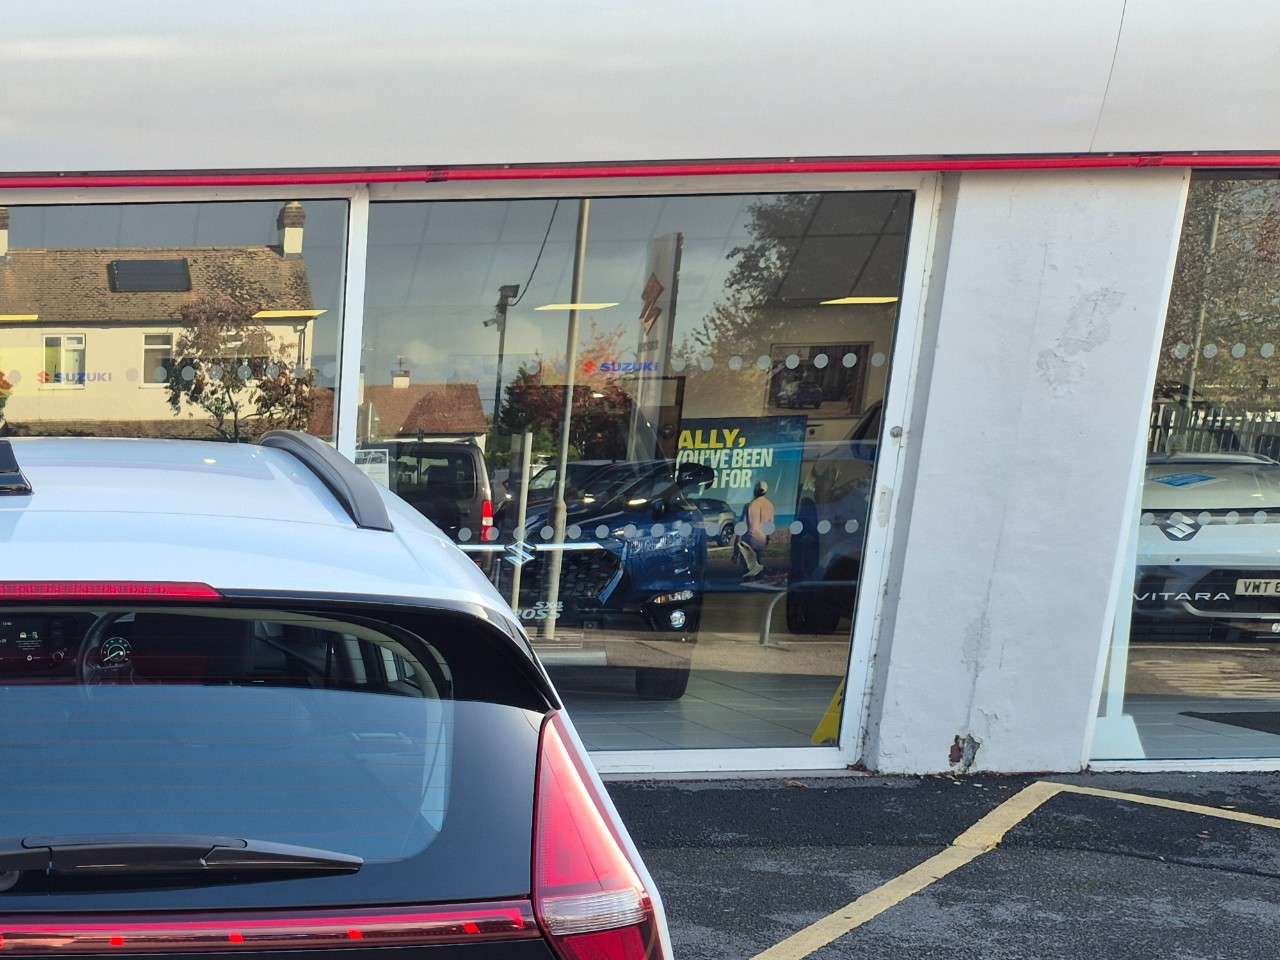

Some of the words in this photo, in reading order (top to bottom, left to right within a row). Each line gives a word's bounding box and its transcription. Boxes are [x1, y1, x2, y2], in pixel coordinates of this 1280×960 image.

[600, 361, 660, 372] SUZUKI
[54, 371, 112, 383] SUZUKI
[732, 448, 774, 468] BEEN
[720, 469, 753, 488] FOR
[1132, 592, 1231, 601] VITARA
